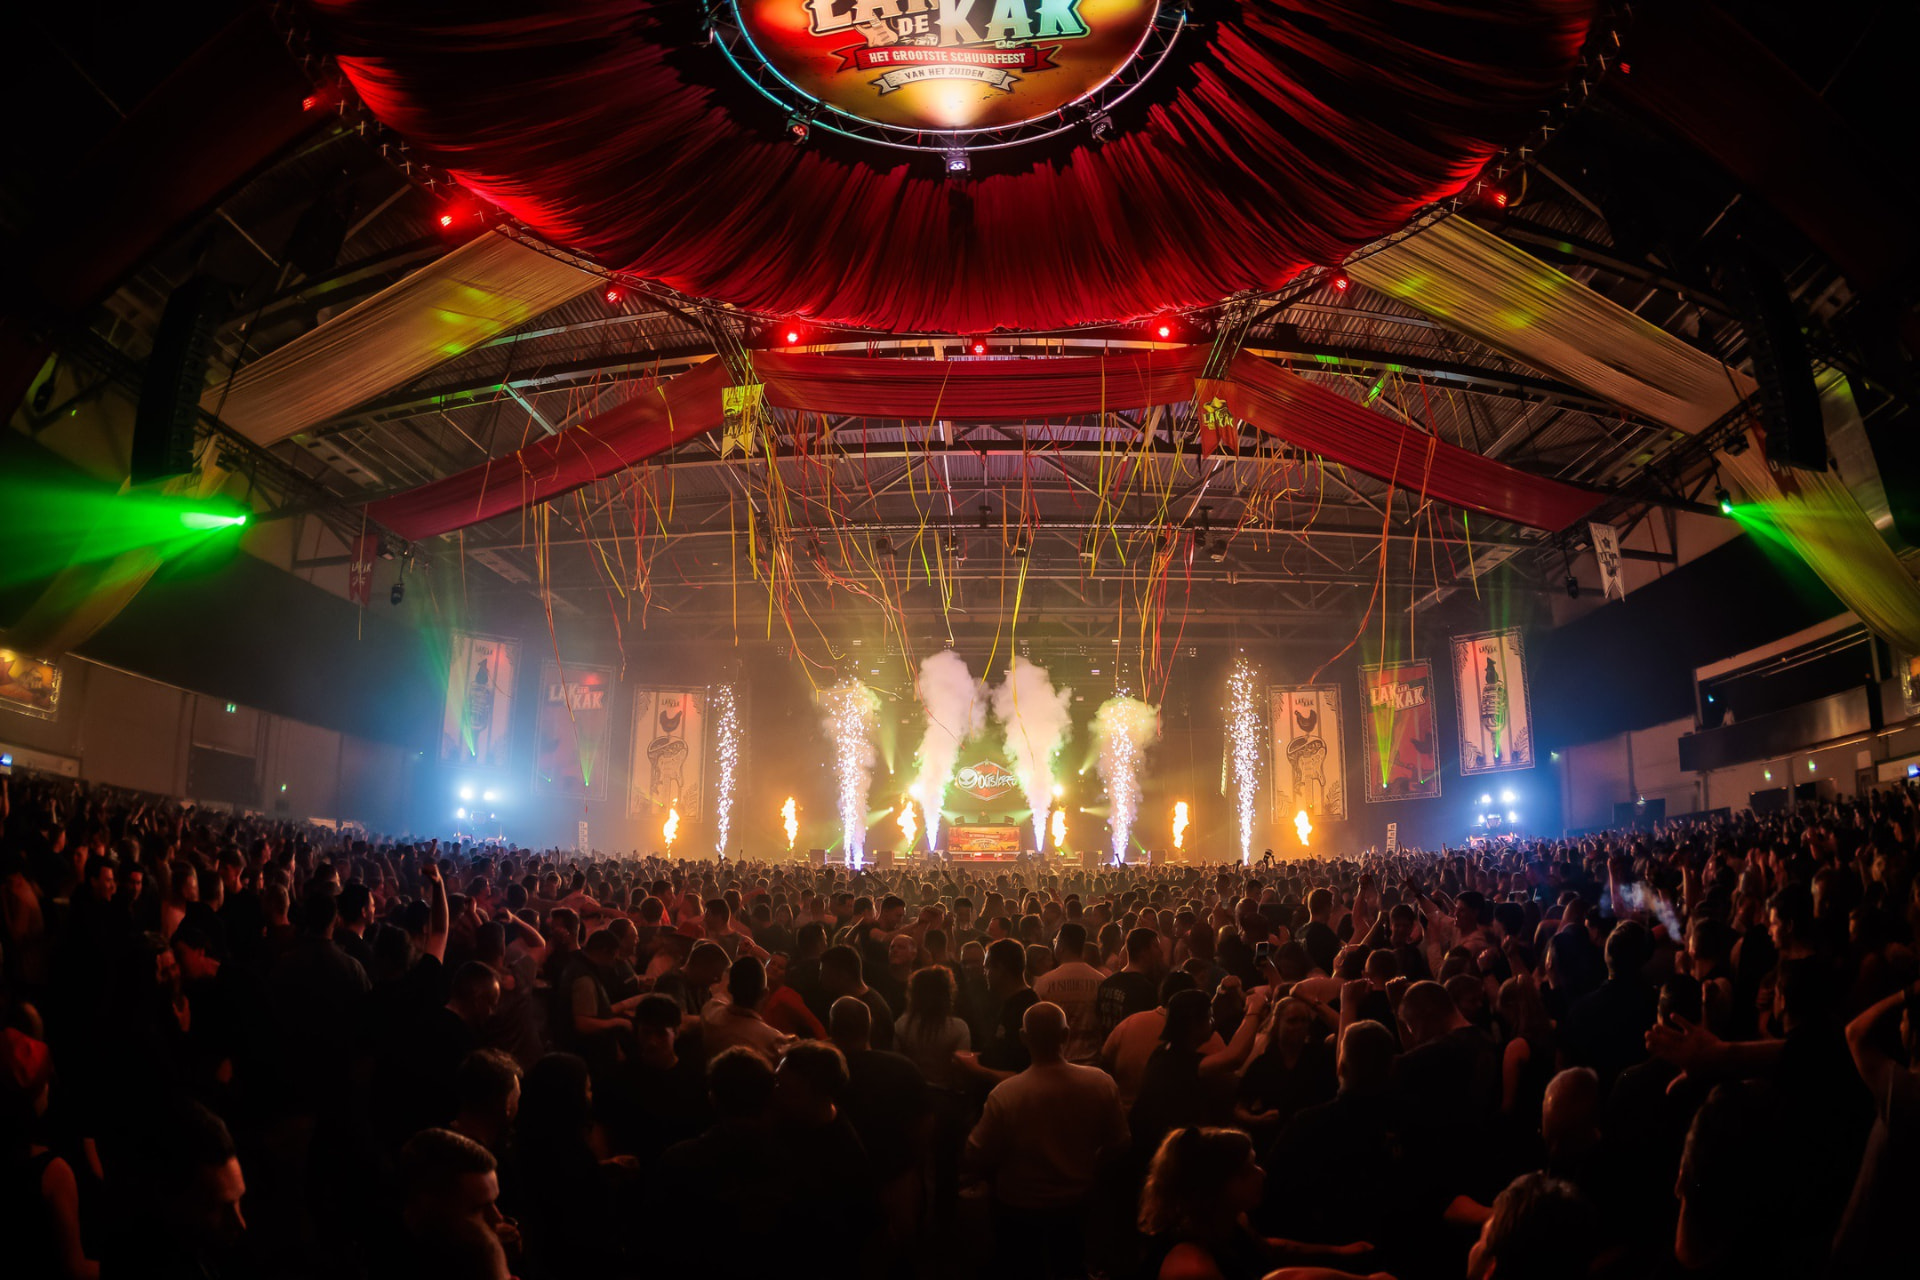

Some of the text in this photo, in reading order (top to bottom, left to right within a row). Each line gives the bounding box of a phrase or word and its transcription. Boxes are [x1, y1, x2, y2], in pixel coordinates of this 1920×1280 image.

[898, 14, 930, 37] DE
[934, 0, 1083, 47] KAK
[869, 50, 1026, 65] HET GROOTSTE SCHUURFEEST
[904, 67, 985, 80] VAN HET ZUIDEN
